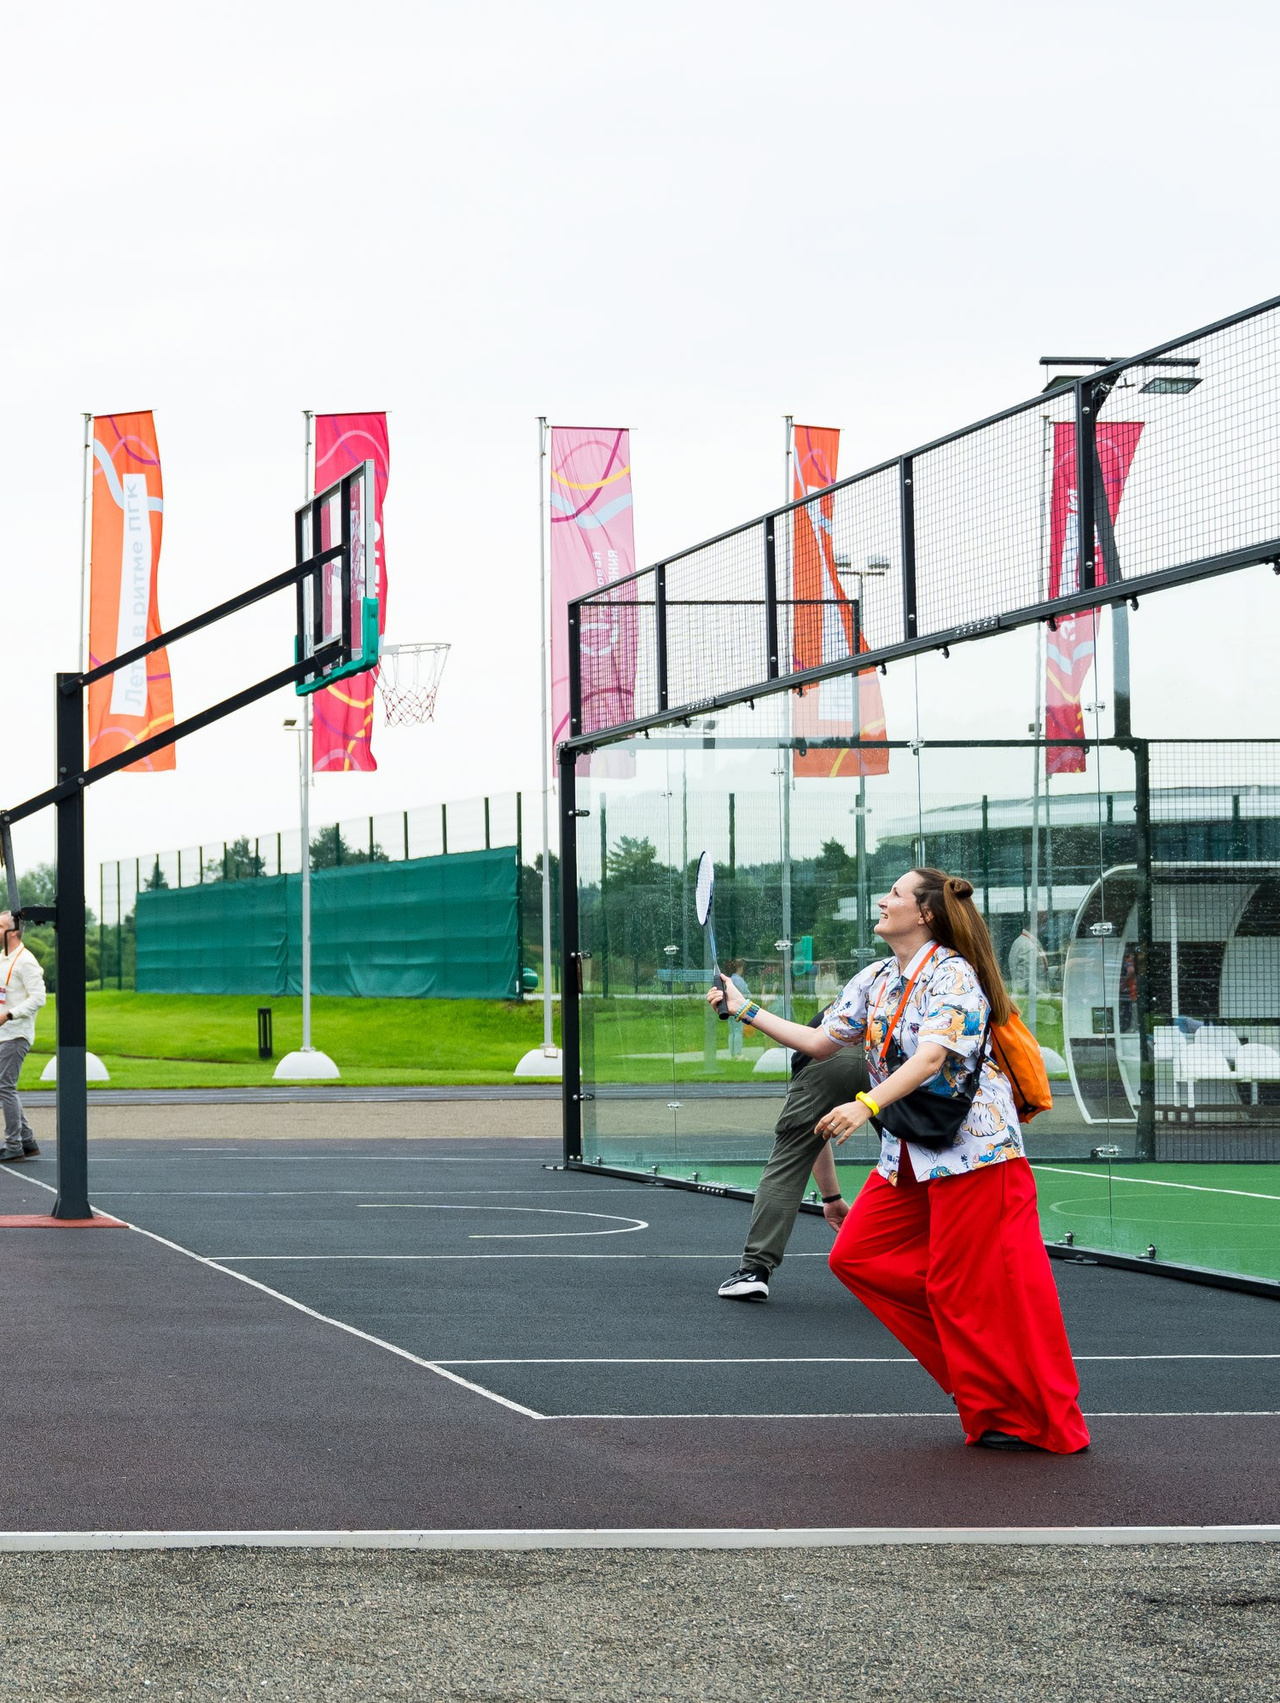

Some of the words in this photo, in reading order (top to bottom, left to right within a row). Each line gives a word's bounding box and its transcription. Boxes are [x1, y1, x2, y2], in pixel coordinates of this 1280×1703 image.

[126, 483, 141, 532] ПГК
[131, 541, 147, 616] ритме
[133, 626, 145, 637] в
[124, 663, 144, 706] Лет
